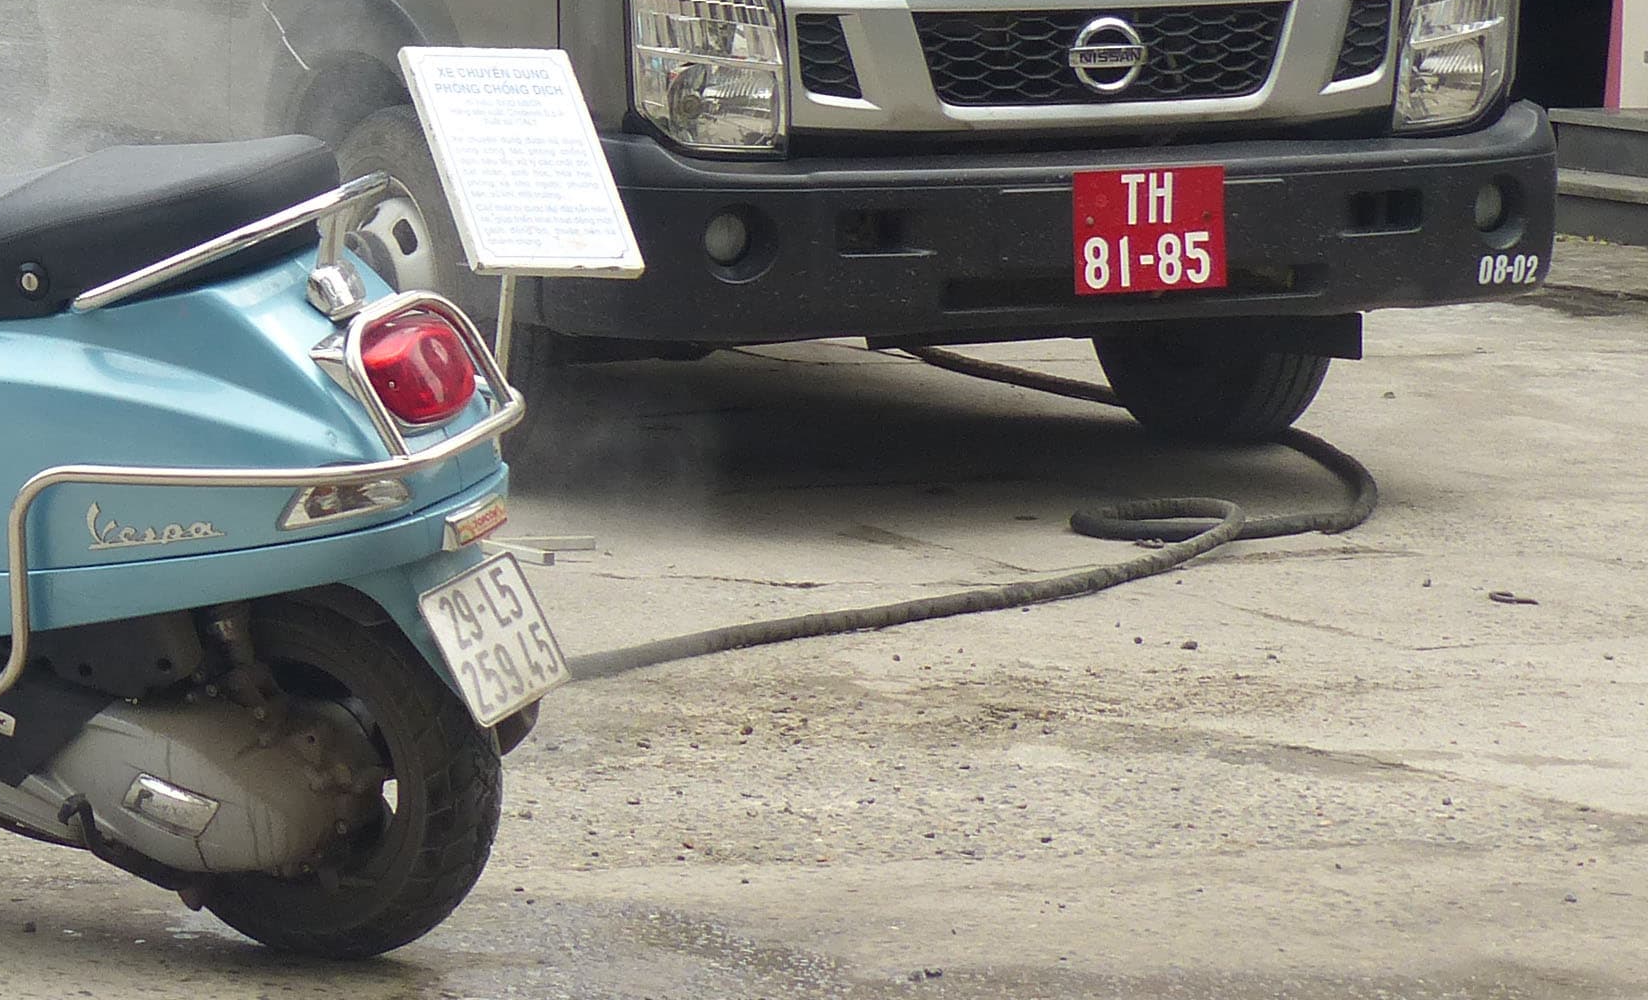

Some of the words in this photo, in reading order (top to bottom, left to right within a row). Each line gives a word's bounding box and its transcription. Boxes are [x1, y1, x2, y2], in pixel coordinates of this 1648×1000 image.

[1079, 49, 1141, 65] NISSAN
[1120, 172, 1174, 226] TH
[1083, 231, 1212, 289] 81-85
[1478, 255, 1539, 285] 08-02
[84, 500, 228, 551] Vespa
[438, 566, 525, 651] 29-L5
[459, 620, 561, 717] 259.45
